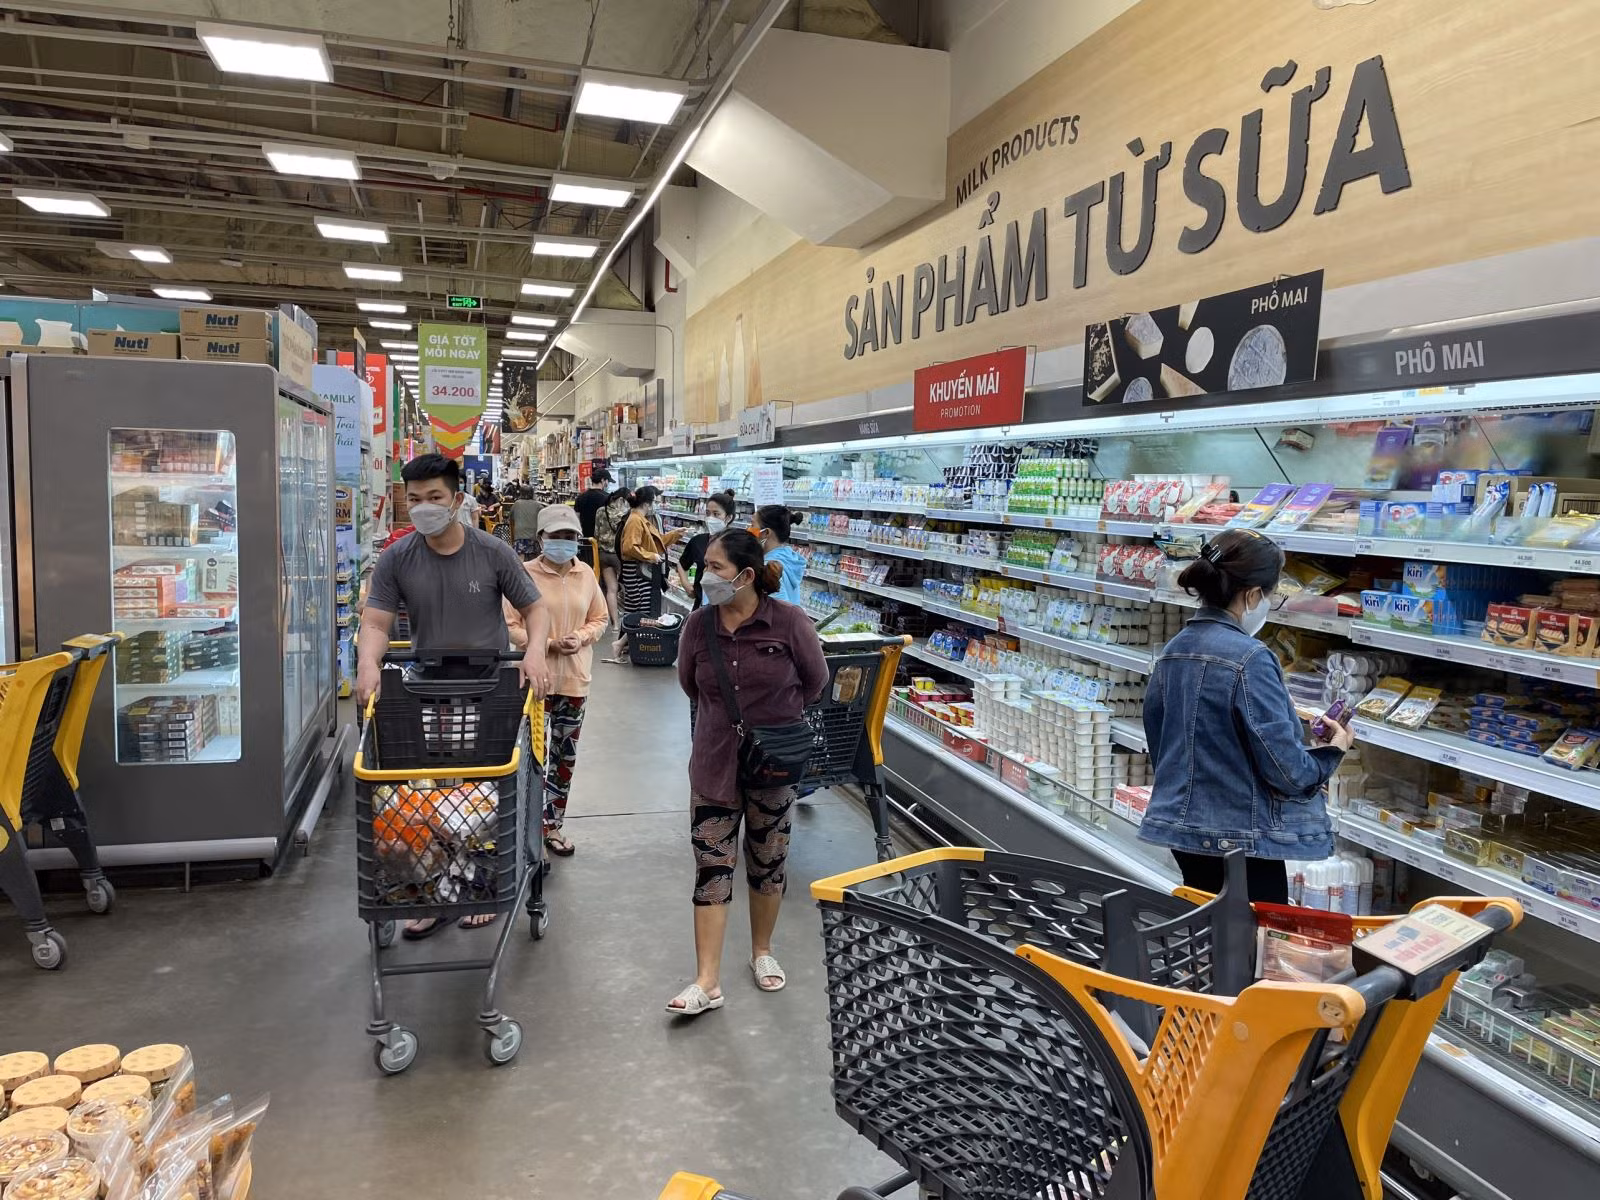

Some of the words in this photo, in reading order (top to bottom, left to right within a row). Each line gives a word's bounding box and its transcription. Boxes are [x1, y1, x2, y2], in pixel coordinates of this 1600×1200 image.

[956, 156, 989, 208] MILK
[992, 115, 1080, 175] PRODUCTS
[844, 267, 904, 360] SẢN
[911, 191, 1048, 339] PHẨM
[1064, 137, 1172, 289] TỪ
[1178, 55, 1412, 254] SỮA
[1251, 289, 1279, 315] PHÔ
[1281, 286, 1308, 308] MAI
[205, 313, 240, 326] Nuti
[114, 336, 149, 349] Nuti
[429, 333, 449, 345] GIÁ
[453, 335, 477, 346] TỐT
[206, 341, 240, 354] Nuti
[449, 348, 480, 360] NGÀY
[1395, 341, 1436, 375] PHÔ
[1441, 340, 1485, 371] MAI
[432, 385, 475, 397] 34.200
[929, 369, 973, 403] KHUYẾN
[976, 366, 1000, 396] MÃI
[320, 393, 356, 404] AMILK
[940, 404, 981, 419] PROMOTION
[336, 507, 351, 519] RM
[1407, 564, 1423, 578] kiri
[1364, 595, 1380, 608] kiri
[1394, 600, 1410, 613] kiri
